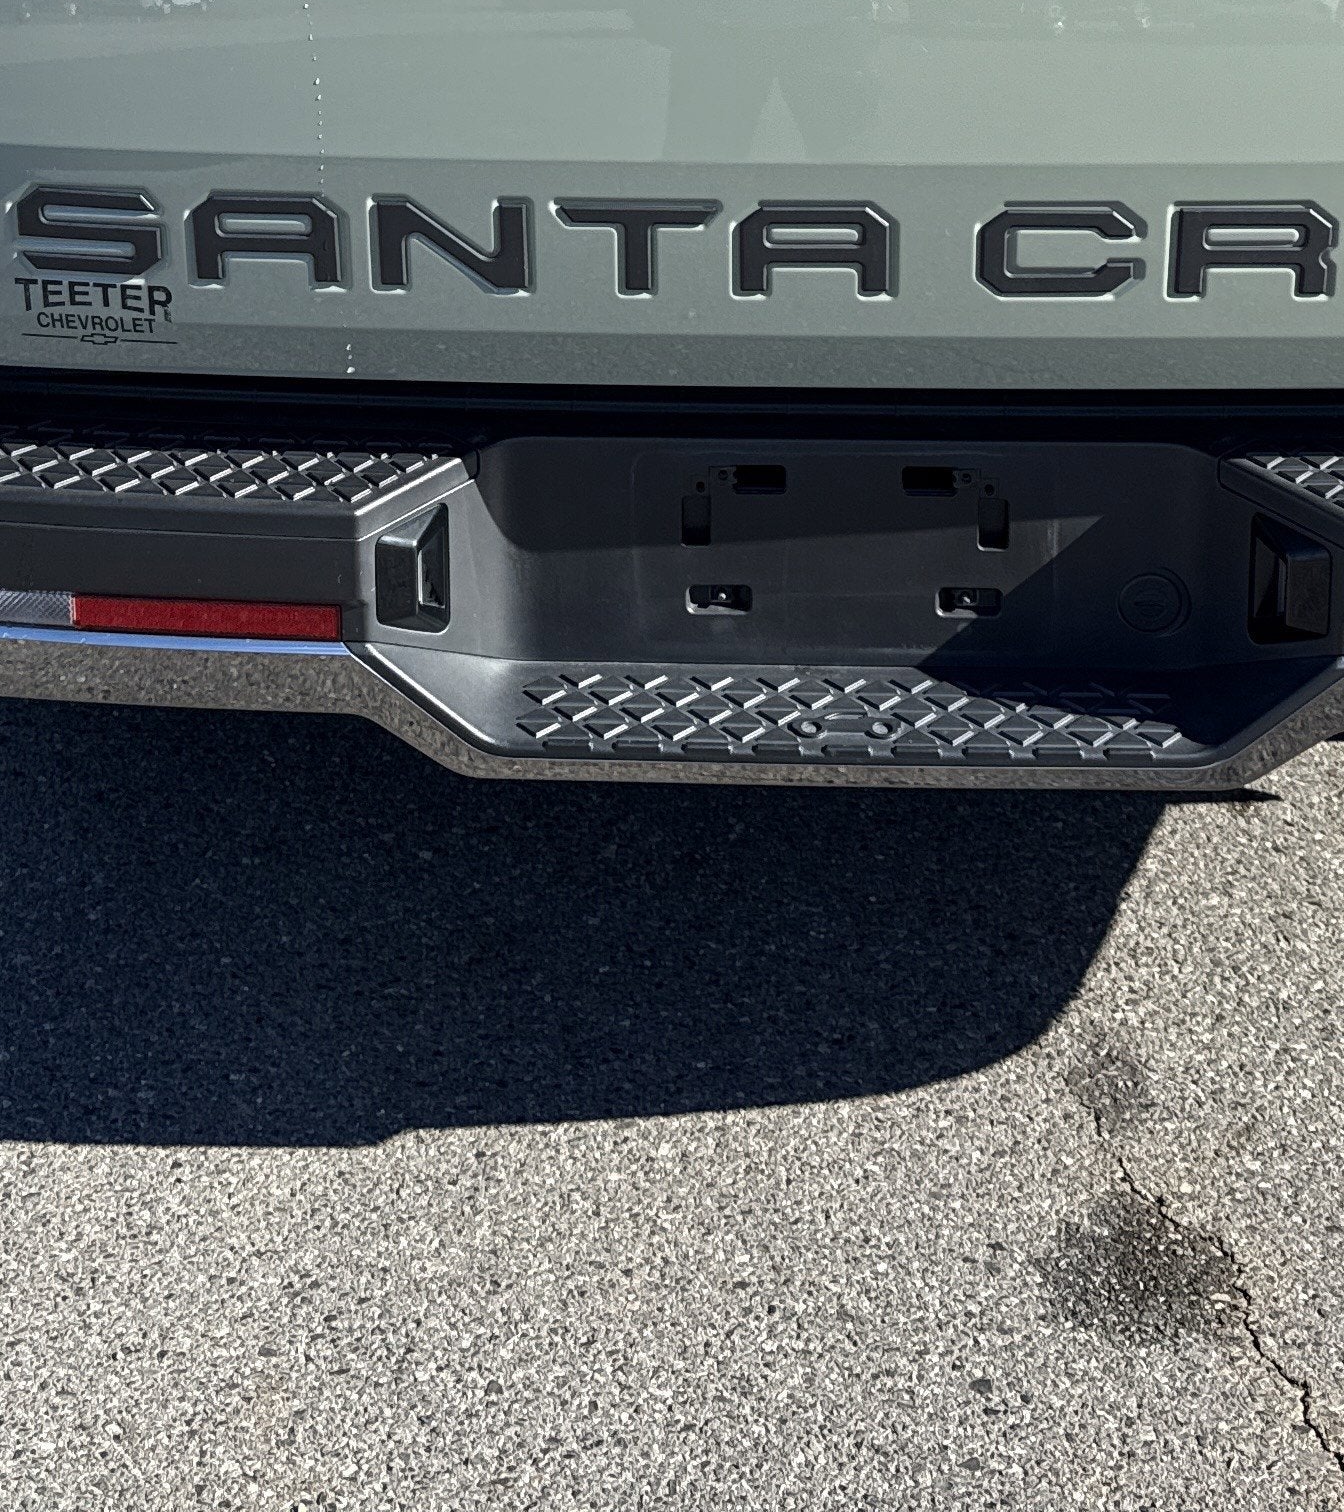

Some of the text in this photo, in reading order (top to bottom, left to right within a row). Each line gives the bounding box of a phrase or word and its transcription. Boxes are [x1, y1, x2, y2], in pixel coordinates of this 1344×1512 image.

[13, 186, 895, 300] SANTA
[14, 277, 174, 322] TEETER
[36, 311, 157, 334] CHEVROLET
